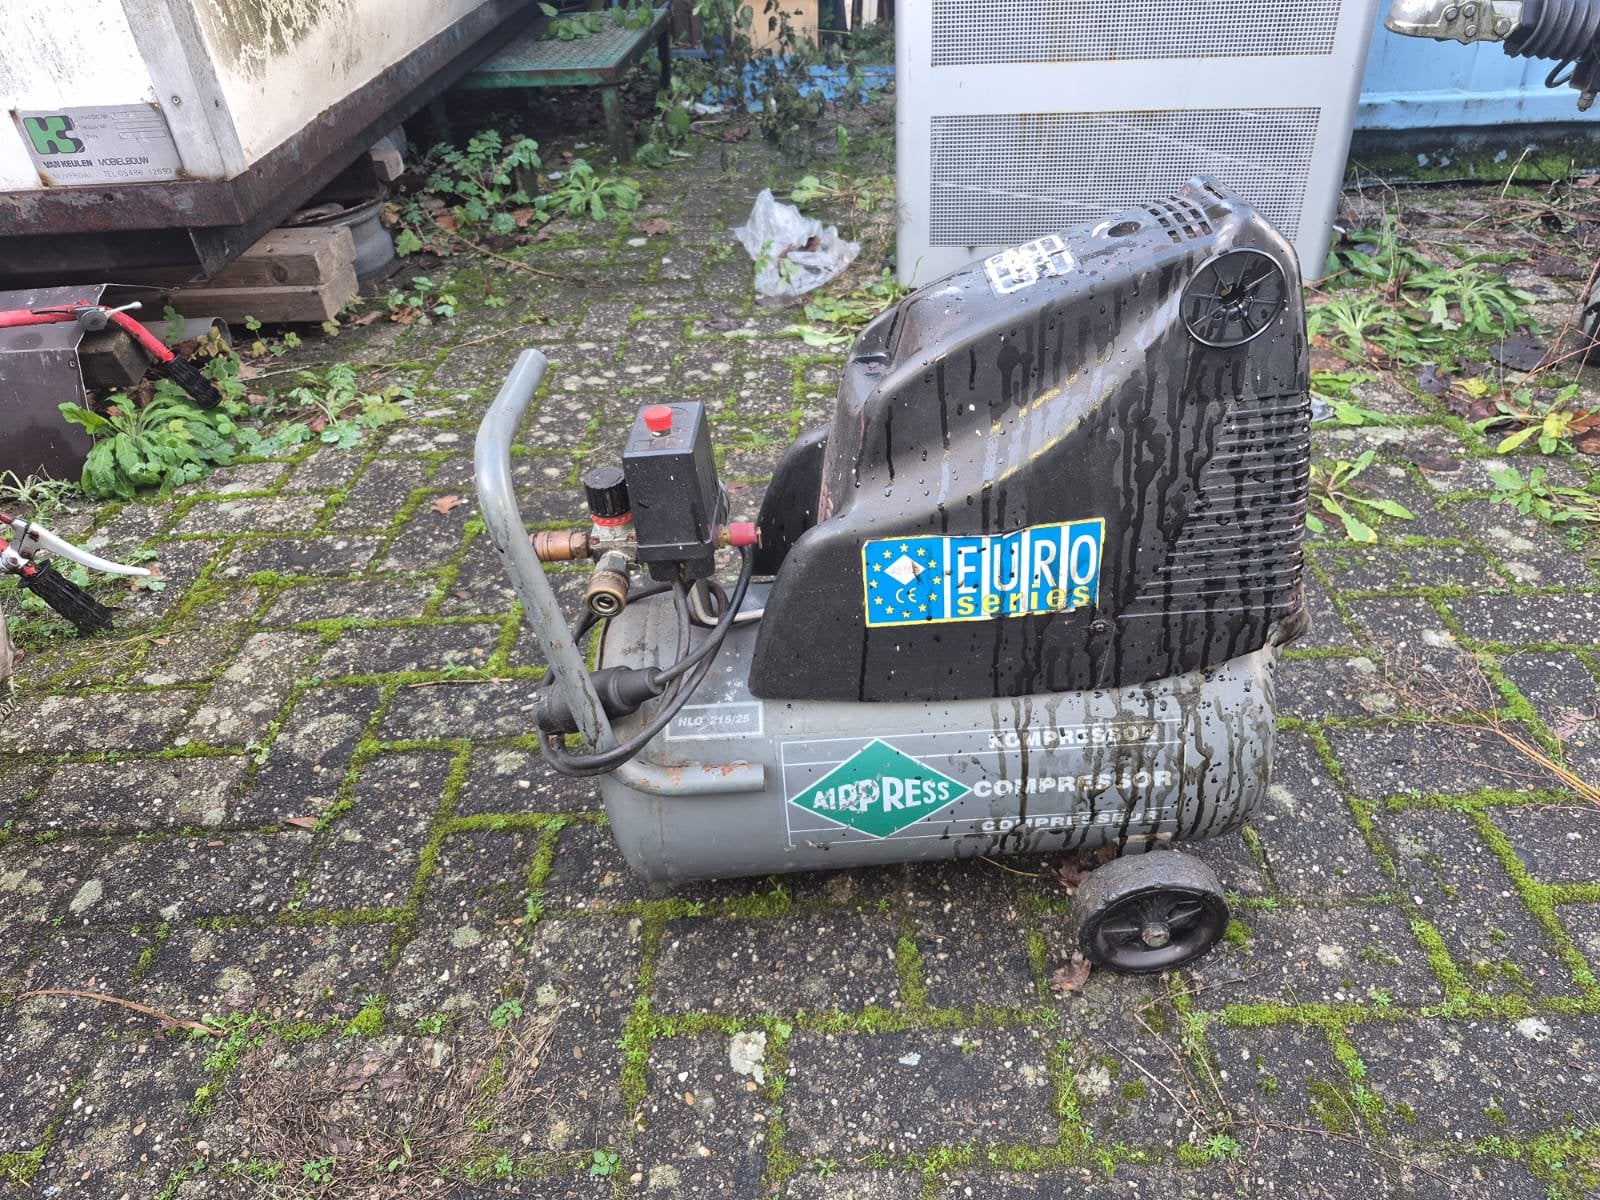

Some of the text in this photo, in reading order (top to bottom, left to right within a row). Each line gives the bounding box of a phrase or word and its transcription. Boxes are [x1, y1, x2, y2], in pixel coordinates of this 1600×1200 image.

[43, 160, 61, 169] VAN
[61, 159, 94, 168] KEULEN
[957, 534, 1097, 594] EURO
[957, 583, 1091, 616] series
[710, 713, 750, 726] 215/25
[812, 776, 950, 813] AIRPRESS
[973, 770, 1172, 798] COMPRESSOR
